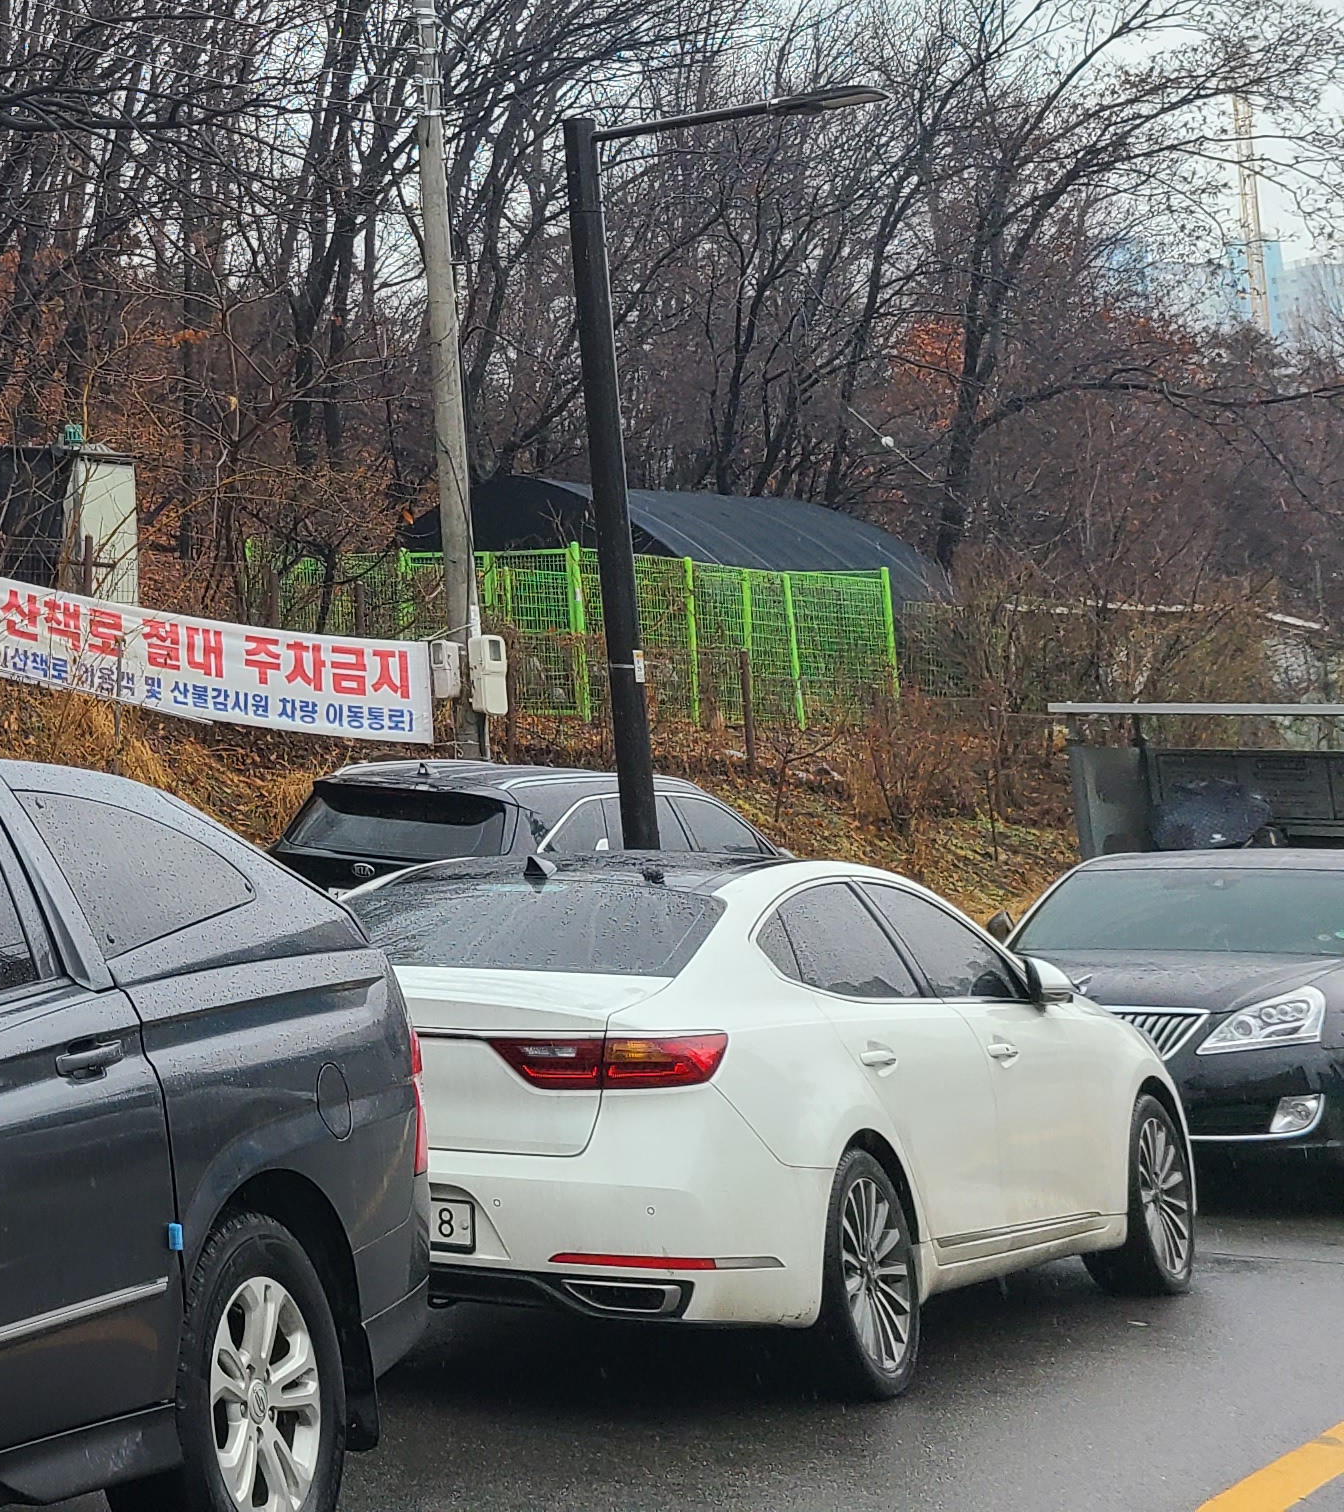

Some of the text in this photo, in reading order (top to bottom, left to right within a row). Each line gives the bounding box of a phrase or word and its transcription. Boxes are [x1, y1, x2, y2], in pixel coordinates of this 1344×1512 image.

[0, 589, 411, 699] 산책로 절대 주차금지
[144, 675, 162, 701] 및
[170, 681, 269, 718] 산불감시원
[278, 697, 318, 724] 차량
[354, 866, 371, 876] KIA
